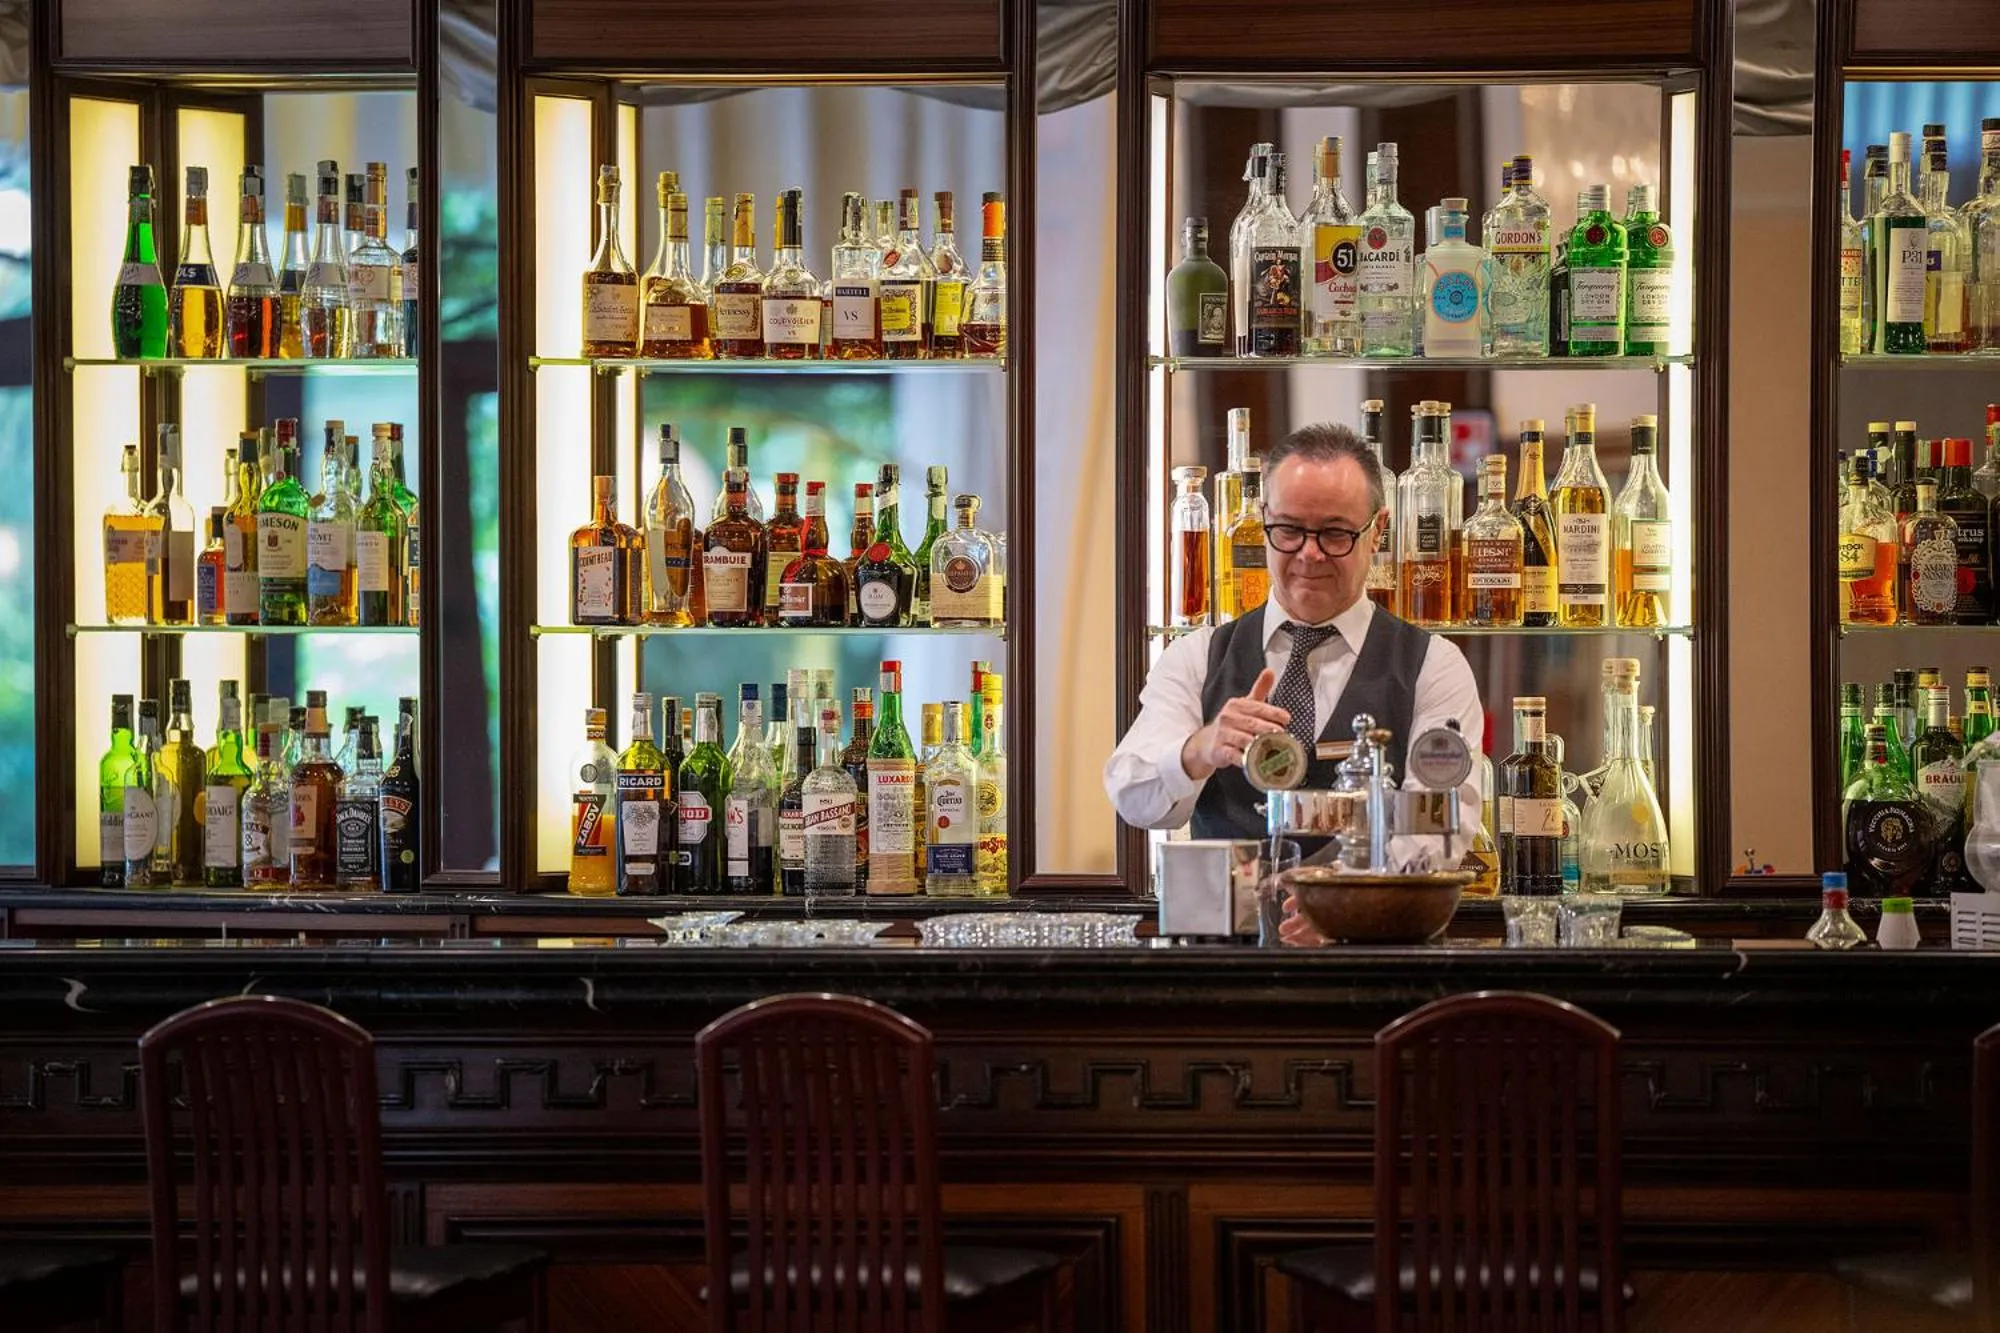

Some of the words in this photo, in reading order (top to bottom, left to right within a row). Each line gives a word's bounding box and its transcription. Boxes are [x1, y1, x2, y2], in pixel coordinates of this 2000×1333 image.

[1494, 231, 1542, 245] GORDON'S
[1336, 248, 1355, 268] 51
[843, 310, 859, 321] VS
[618, 776, 663, 788] RICARD
